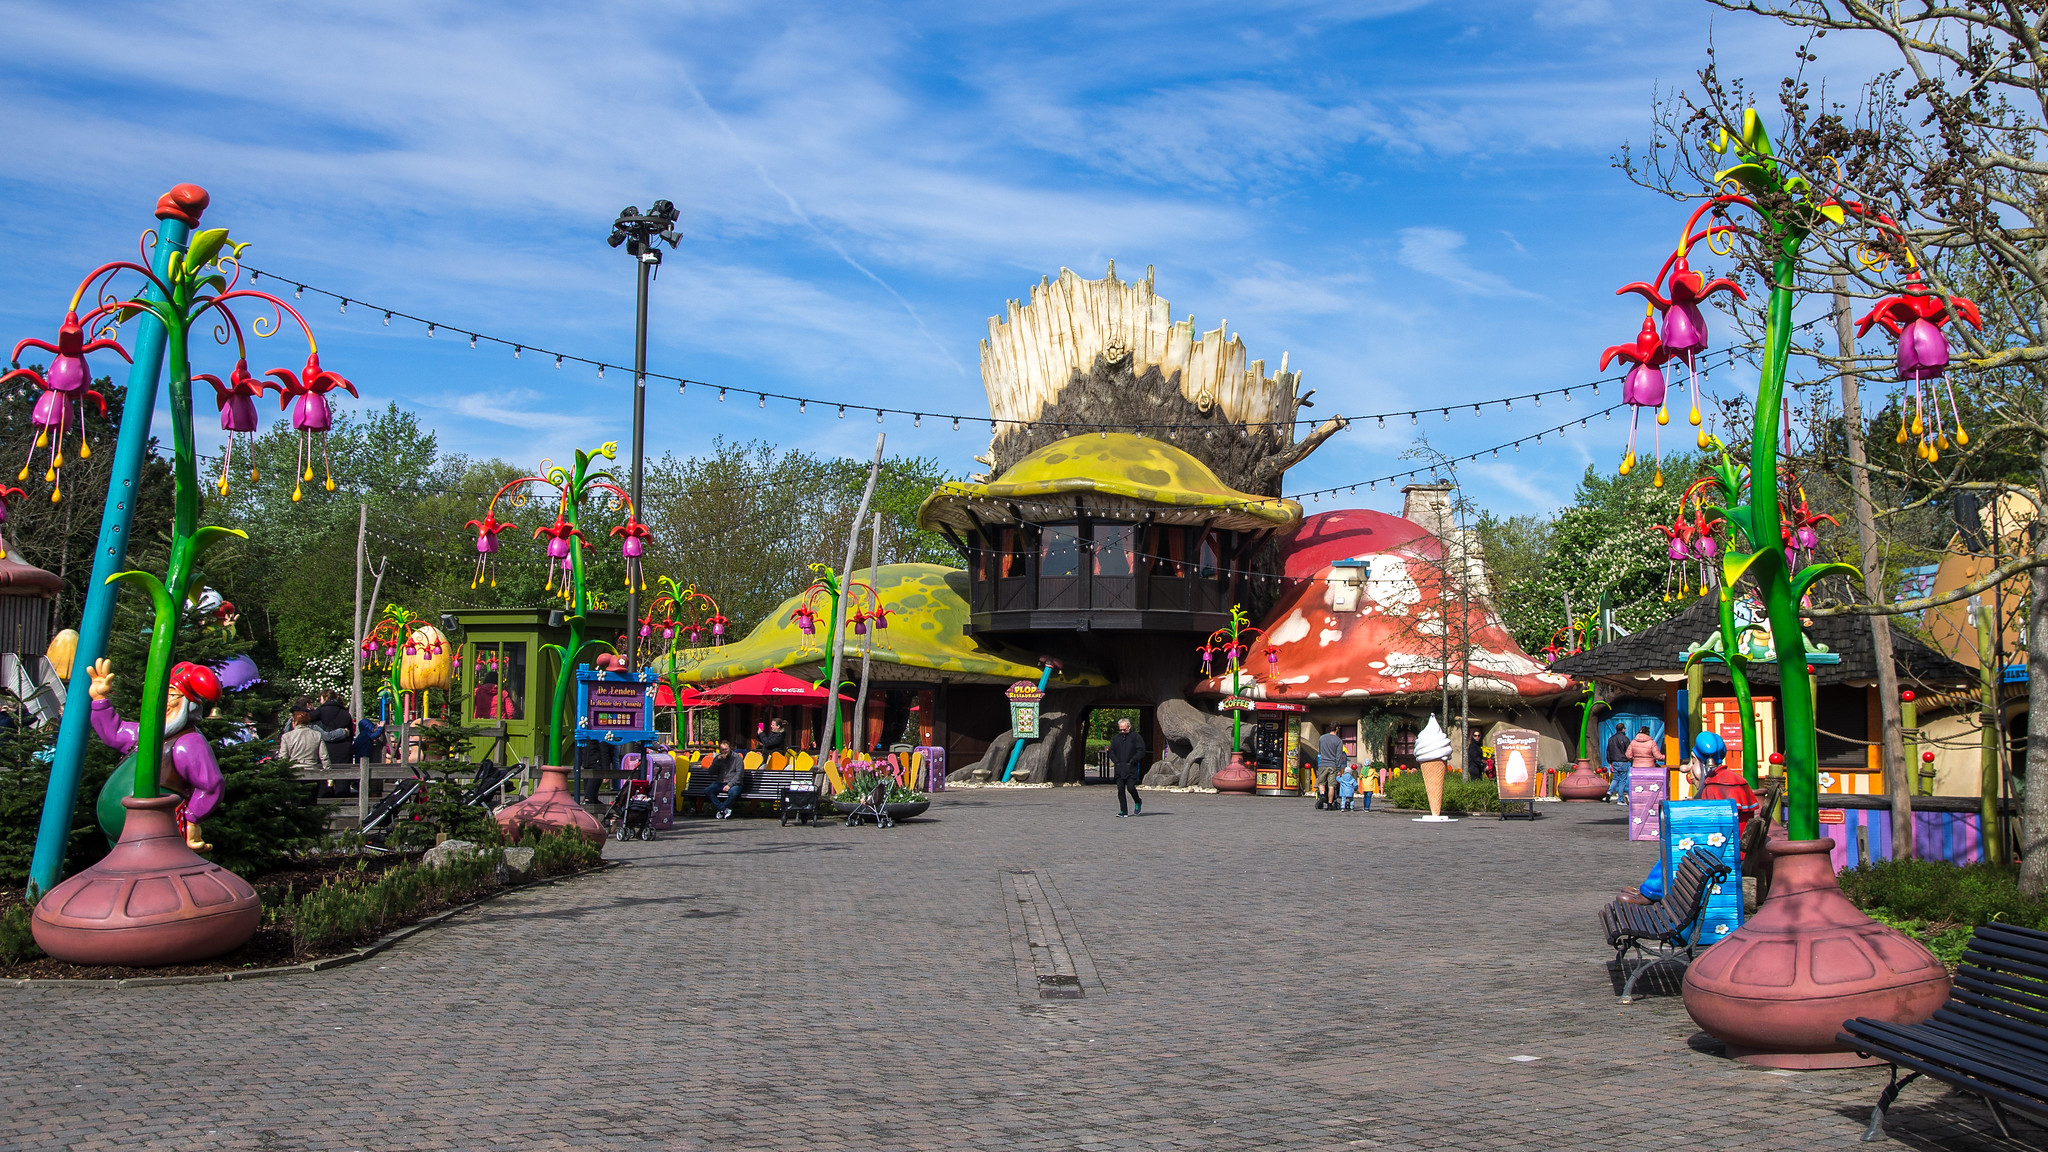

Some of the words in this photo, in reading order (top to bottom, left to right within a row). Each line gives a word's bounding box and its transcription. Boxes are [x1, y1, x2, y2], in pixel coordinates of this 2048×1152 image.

[598, 686, 607, 695] De
[610, 686, 636, 696] Eenden
[1014, 686, 1037, 694] PLOP
[1224, 699, 1249, 709] COFFEE
